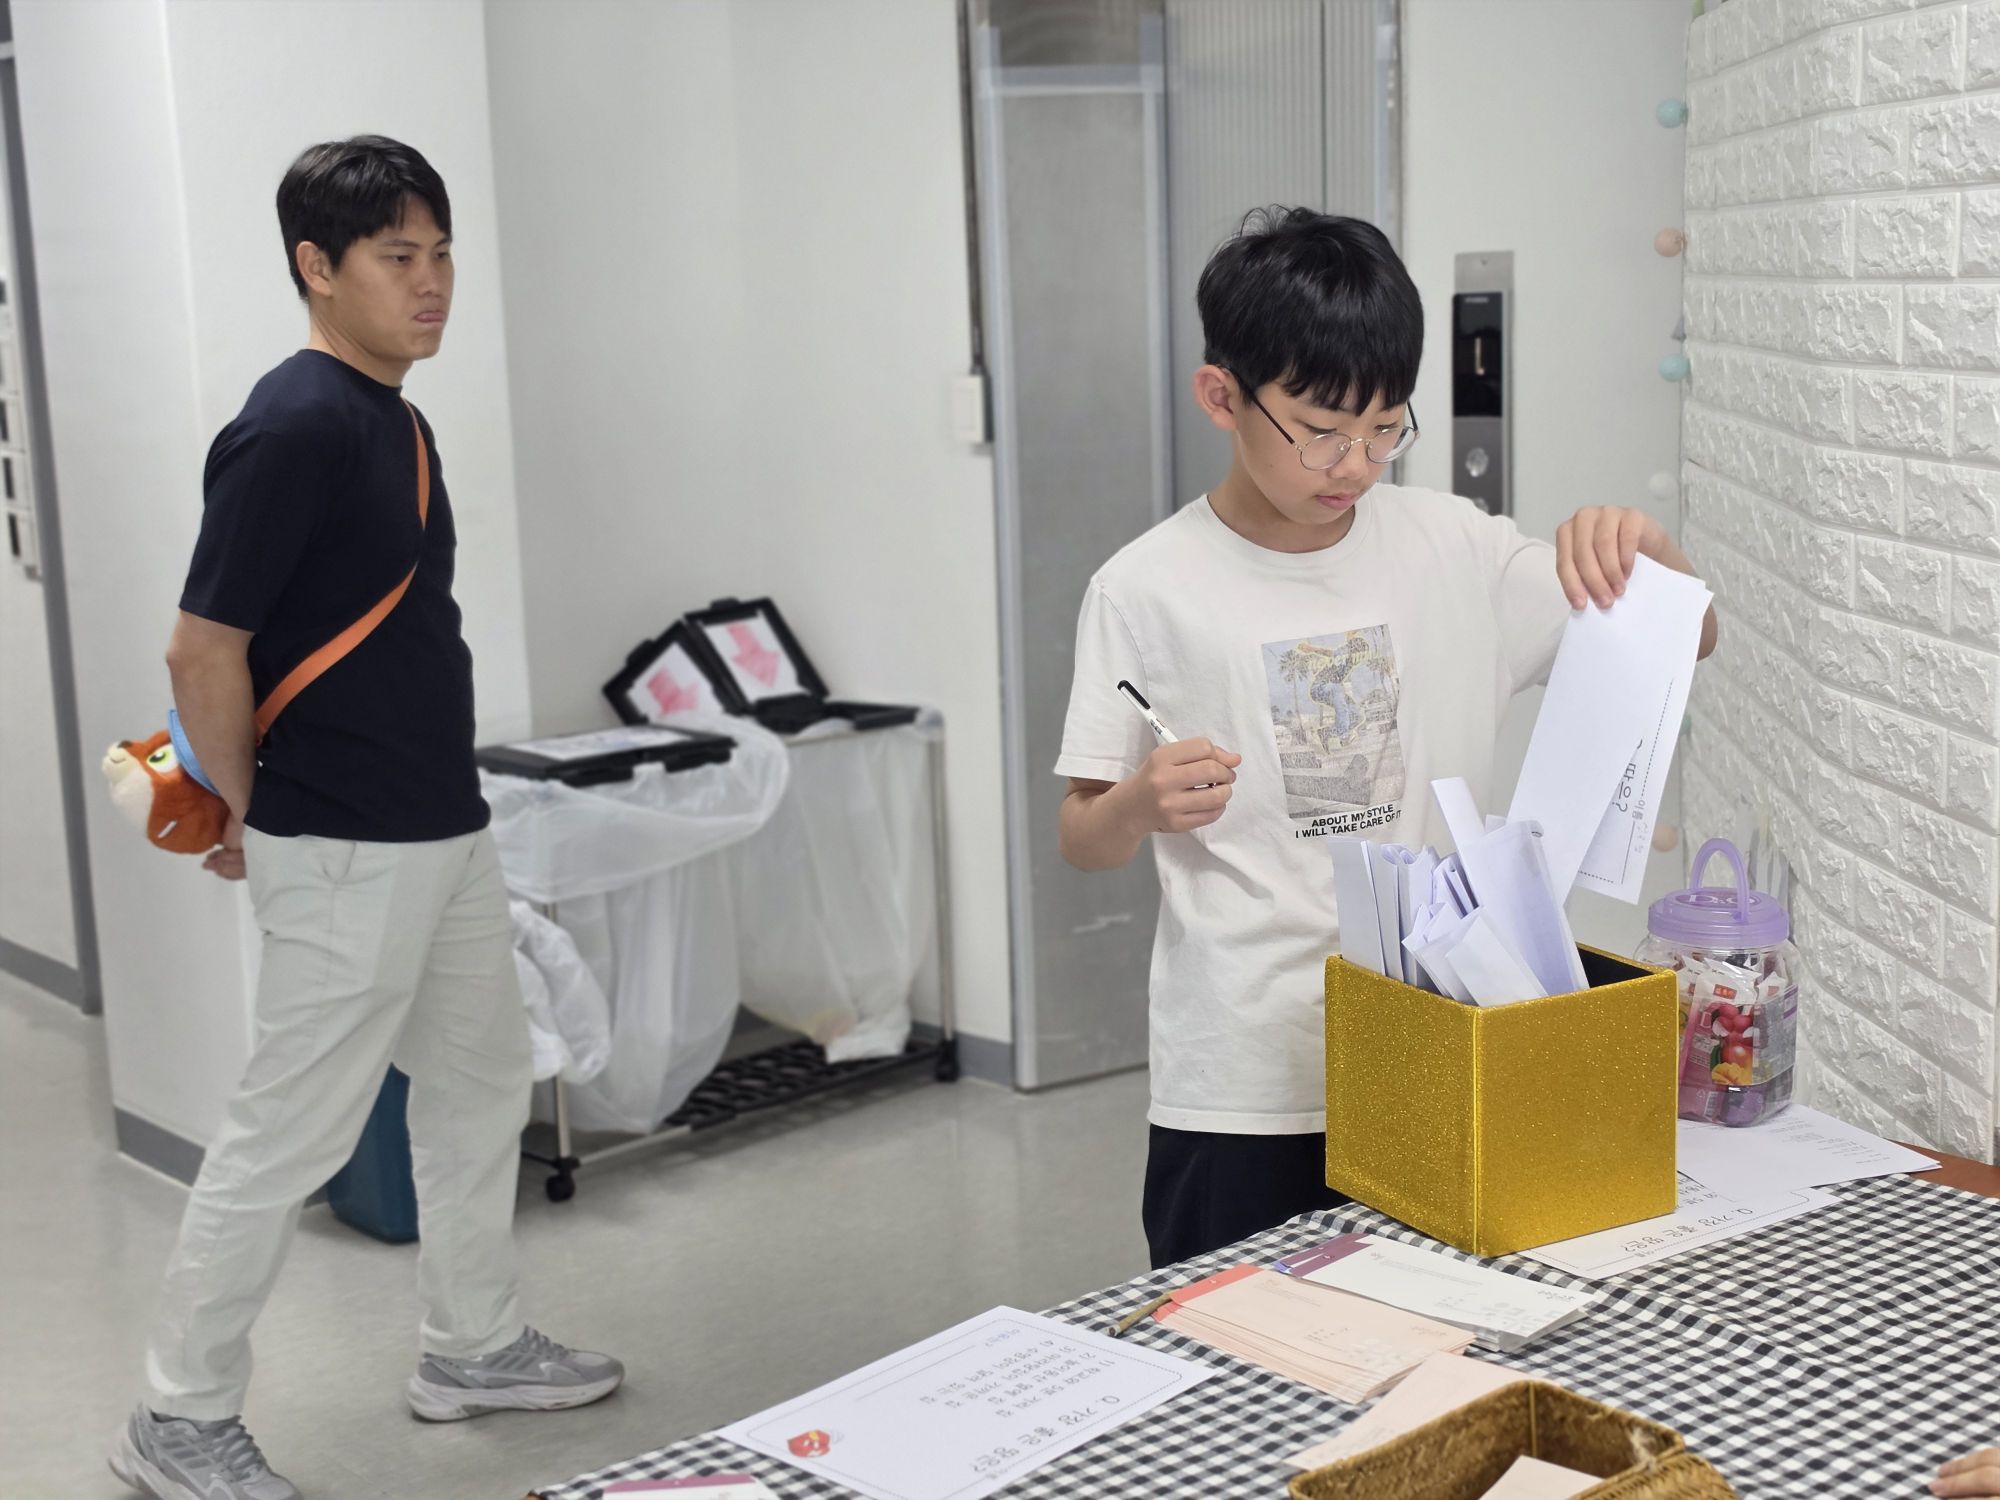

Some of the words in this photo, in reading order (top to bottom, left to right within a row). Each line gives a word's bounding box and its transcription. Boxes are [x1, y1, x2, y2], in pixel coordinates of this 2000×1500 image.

[1311, 814, 1348, 828] ABOUT
[1351, 811, 1366, 823] MY
[1366, 804, 1394, 818] STYLE
[1631, 800, 1647, 820] 이름
[1295, 830, 1299, 839] I
[1301, 828, 1328, 838] WILL
[1330, 823, 1358, 835] TAKE
[1359, 816, 1384, 830] CARE
[1385, 813, 1396, 825] OF
[1731, 1207, 1753, 1216] Q.
[1697, 1214, 1732, 1228] 가장
[1663, 1224, 1698, 1239] 좋은
[1620, 1236, 1665, 1253] 땅은?
[1031, 1359, 1081, 1382] 놀이동산
[1062, 1367, 1102, 1385] 학교와
[1040, 1384, 1065, 1395] 5분
[1096, 1394, 1121, 1405] Q.
[1057, 1407, 1098, 1426] 가장
[1016, 1426, 1058, 1446] 좋은
[971, 1447, 1020, 1472] 땅은?
